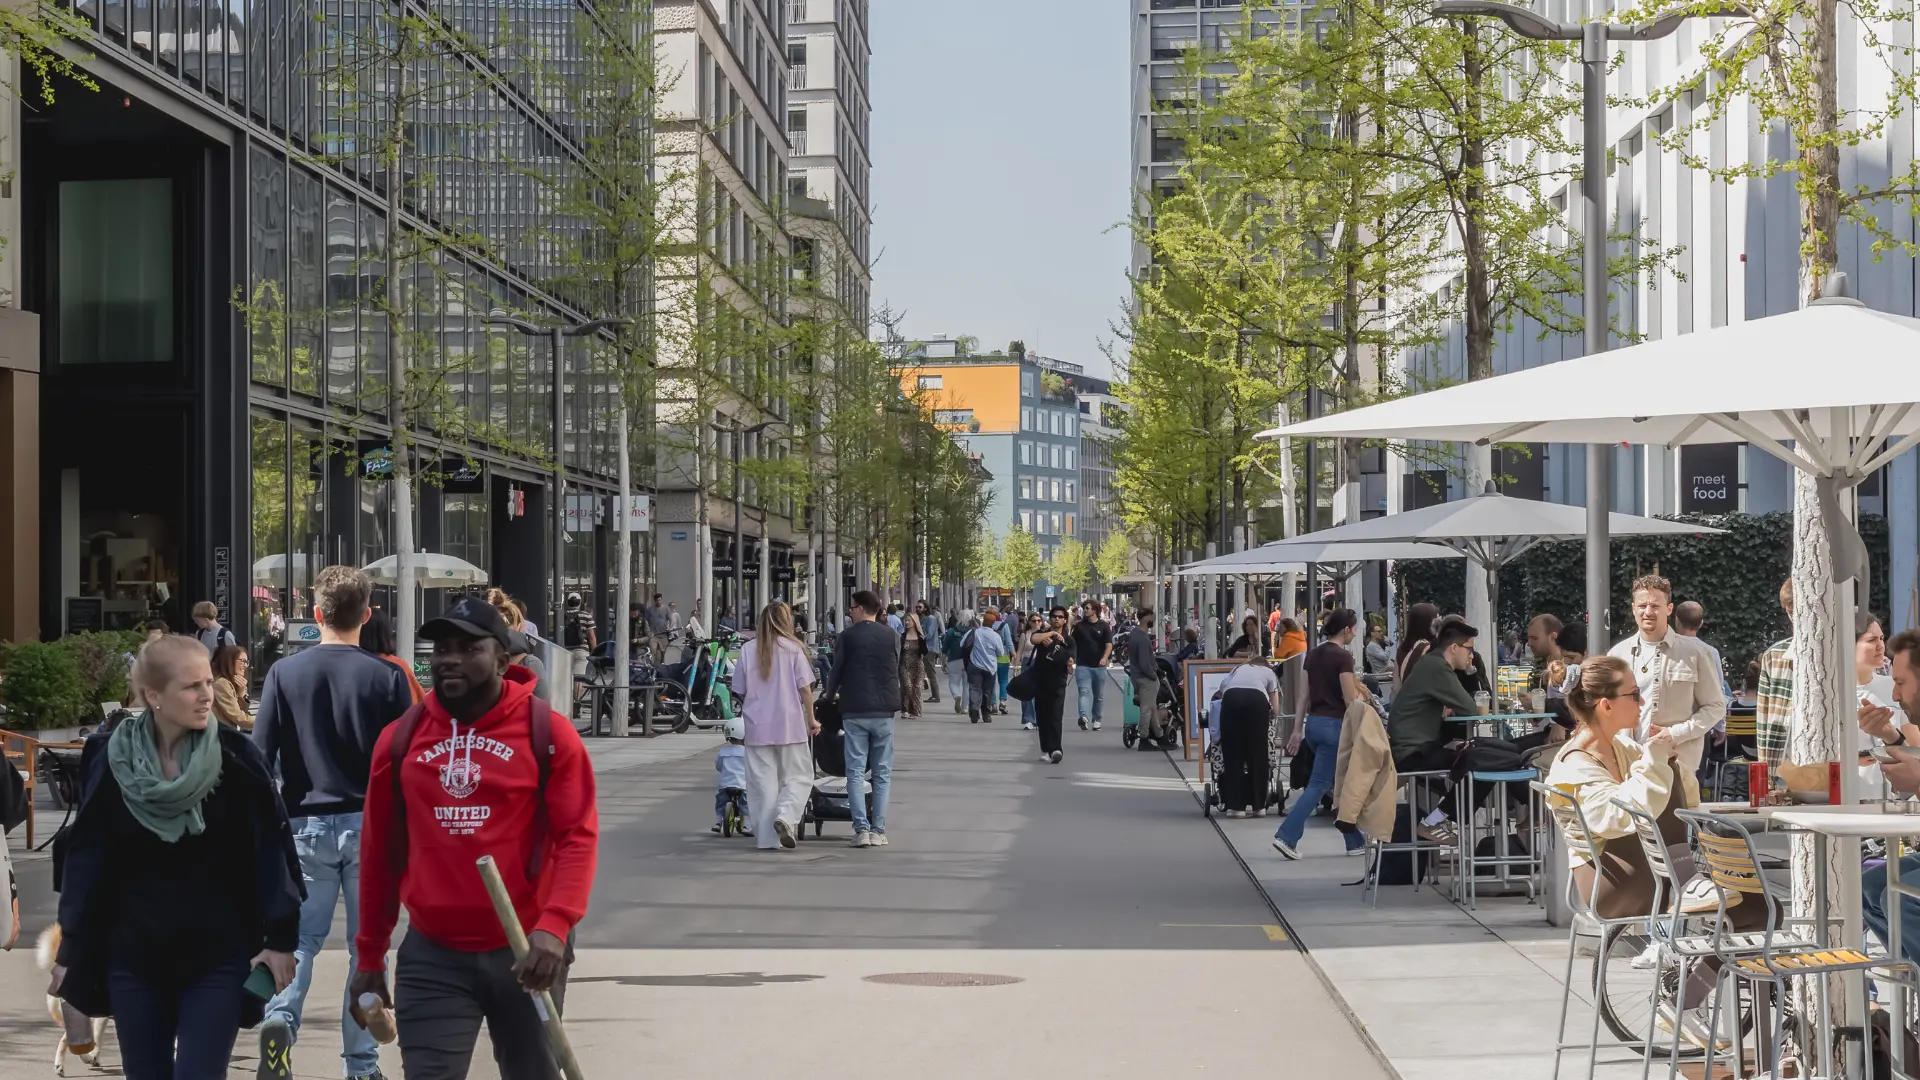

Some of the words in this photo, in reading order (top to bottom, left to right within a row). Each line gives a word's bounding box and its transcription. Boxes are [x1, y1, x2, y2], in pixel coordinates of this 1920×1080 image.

[1693, 474, 1726, 485] meet
[1693, 486, 1727, 499] food
[433, 805, 491, 820] UNITED
